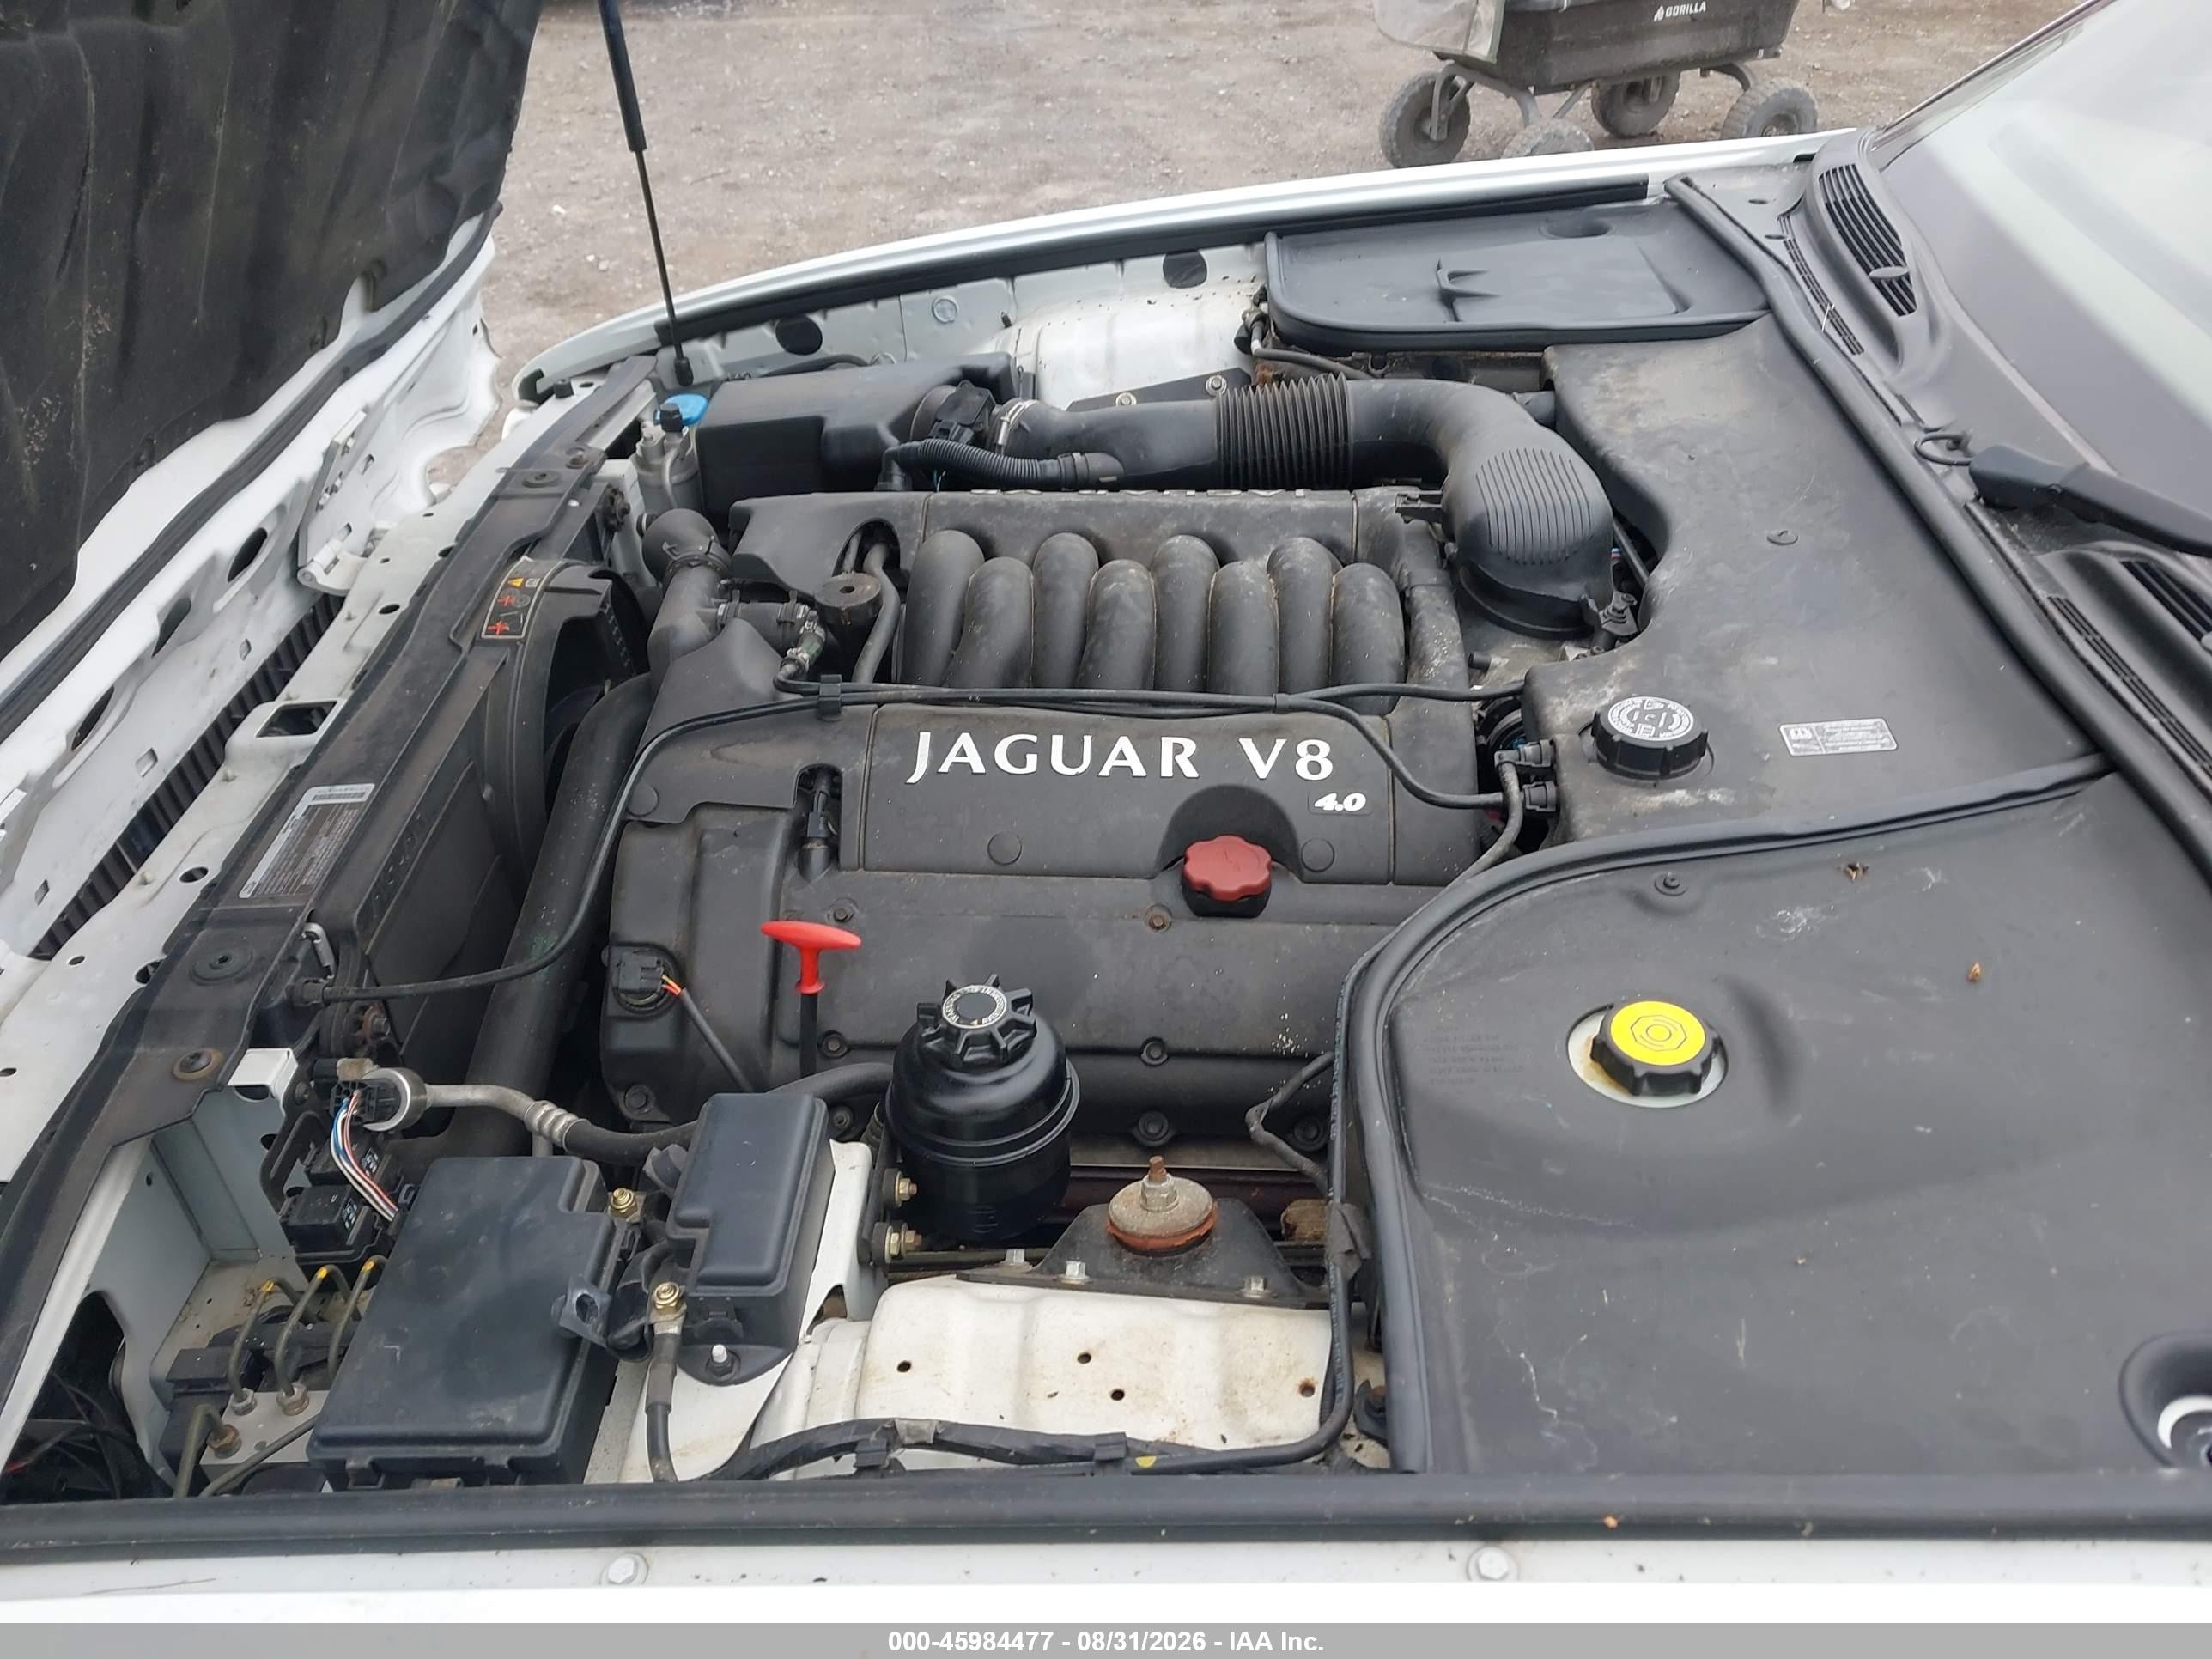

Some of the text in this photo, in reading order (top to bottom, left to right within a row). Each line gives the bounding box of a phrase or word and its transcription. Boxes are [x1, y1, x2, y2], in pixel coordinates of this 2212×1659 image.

[1664, 1, 1707, 18] GORILLA
[906, 732, 1334, 784] JAGUAR V8
[1314, 792, 1368, 812] 4.0
